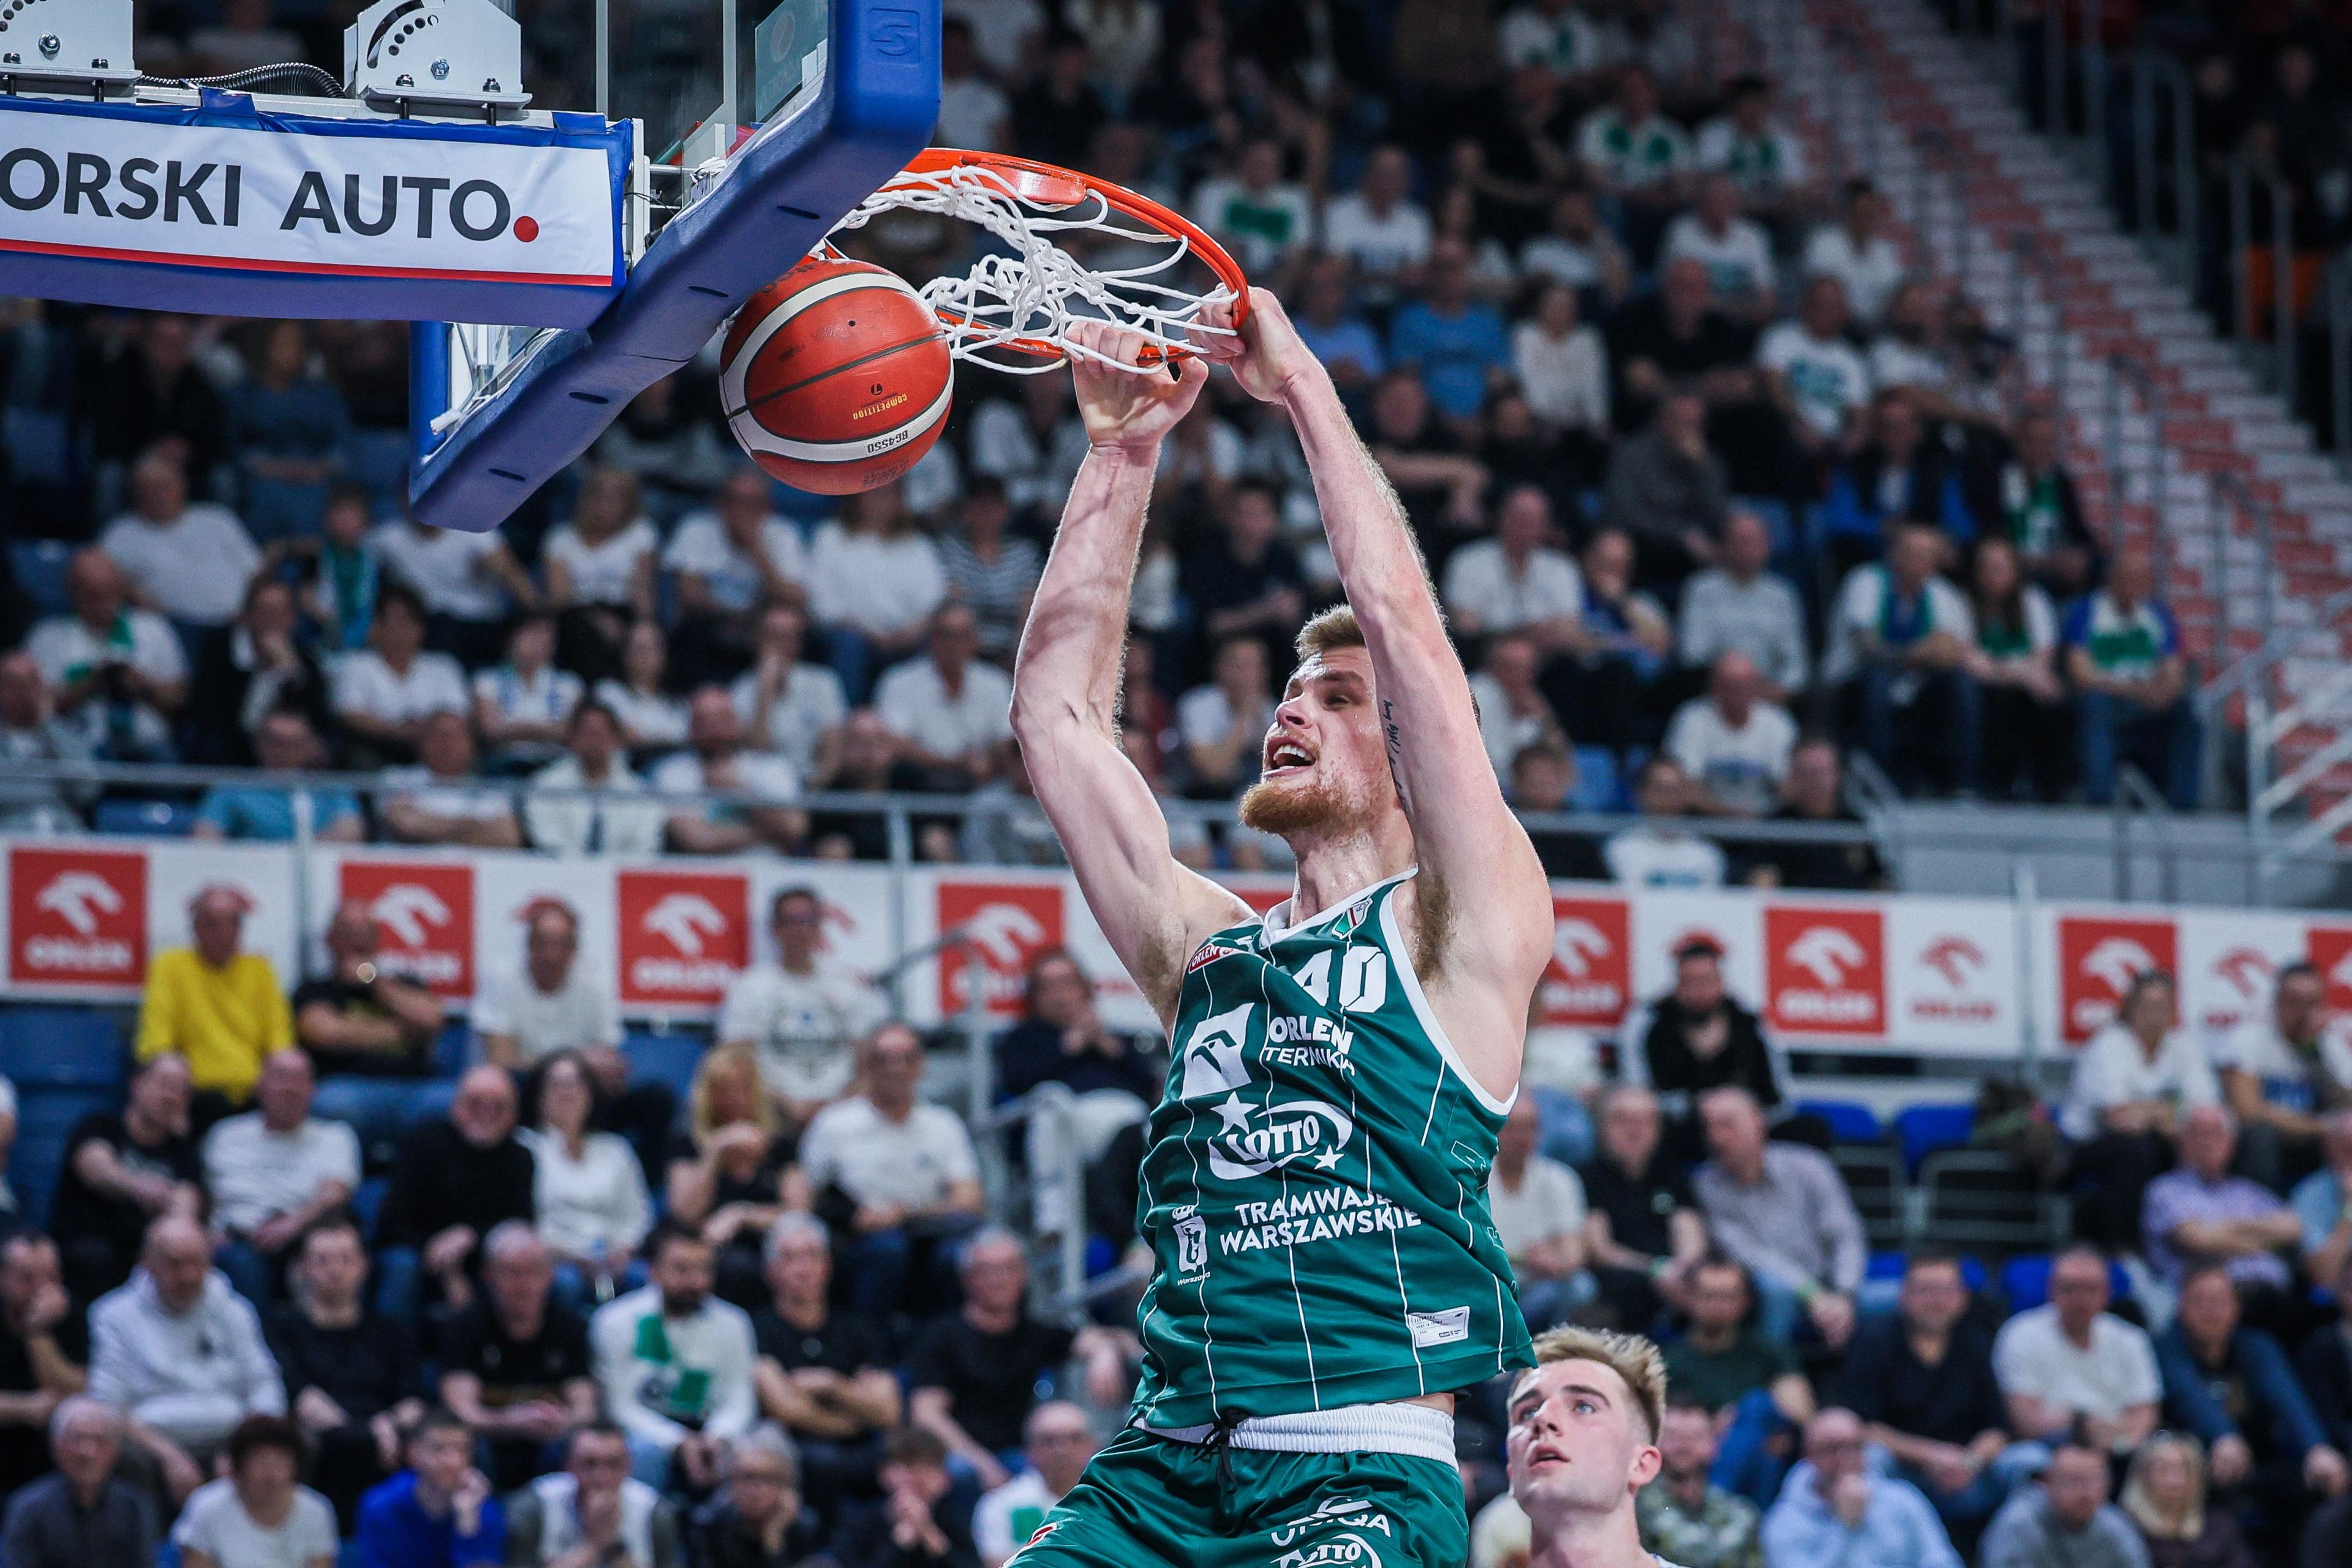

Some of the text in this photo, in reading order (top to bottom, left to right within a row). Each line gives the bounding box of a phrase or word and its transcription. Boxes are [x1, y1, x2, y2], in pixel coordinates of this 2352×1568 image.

[0, 148, 241, 227] ORSKI
[853, 393, 907, 420] COMPETITION
[867, 430, 908, 453] BG4550
[1191, 944, 1220, 967] ORLEN
[1292, 946, 1387, 1013] 40
[1269, 1016, 1354, 1055] ORLEN
[1226, 1115, 1320, 1161] LOTTO
[1219, 1205, 1422, 1256] WARSZAWSKIE
